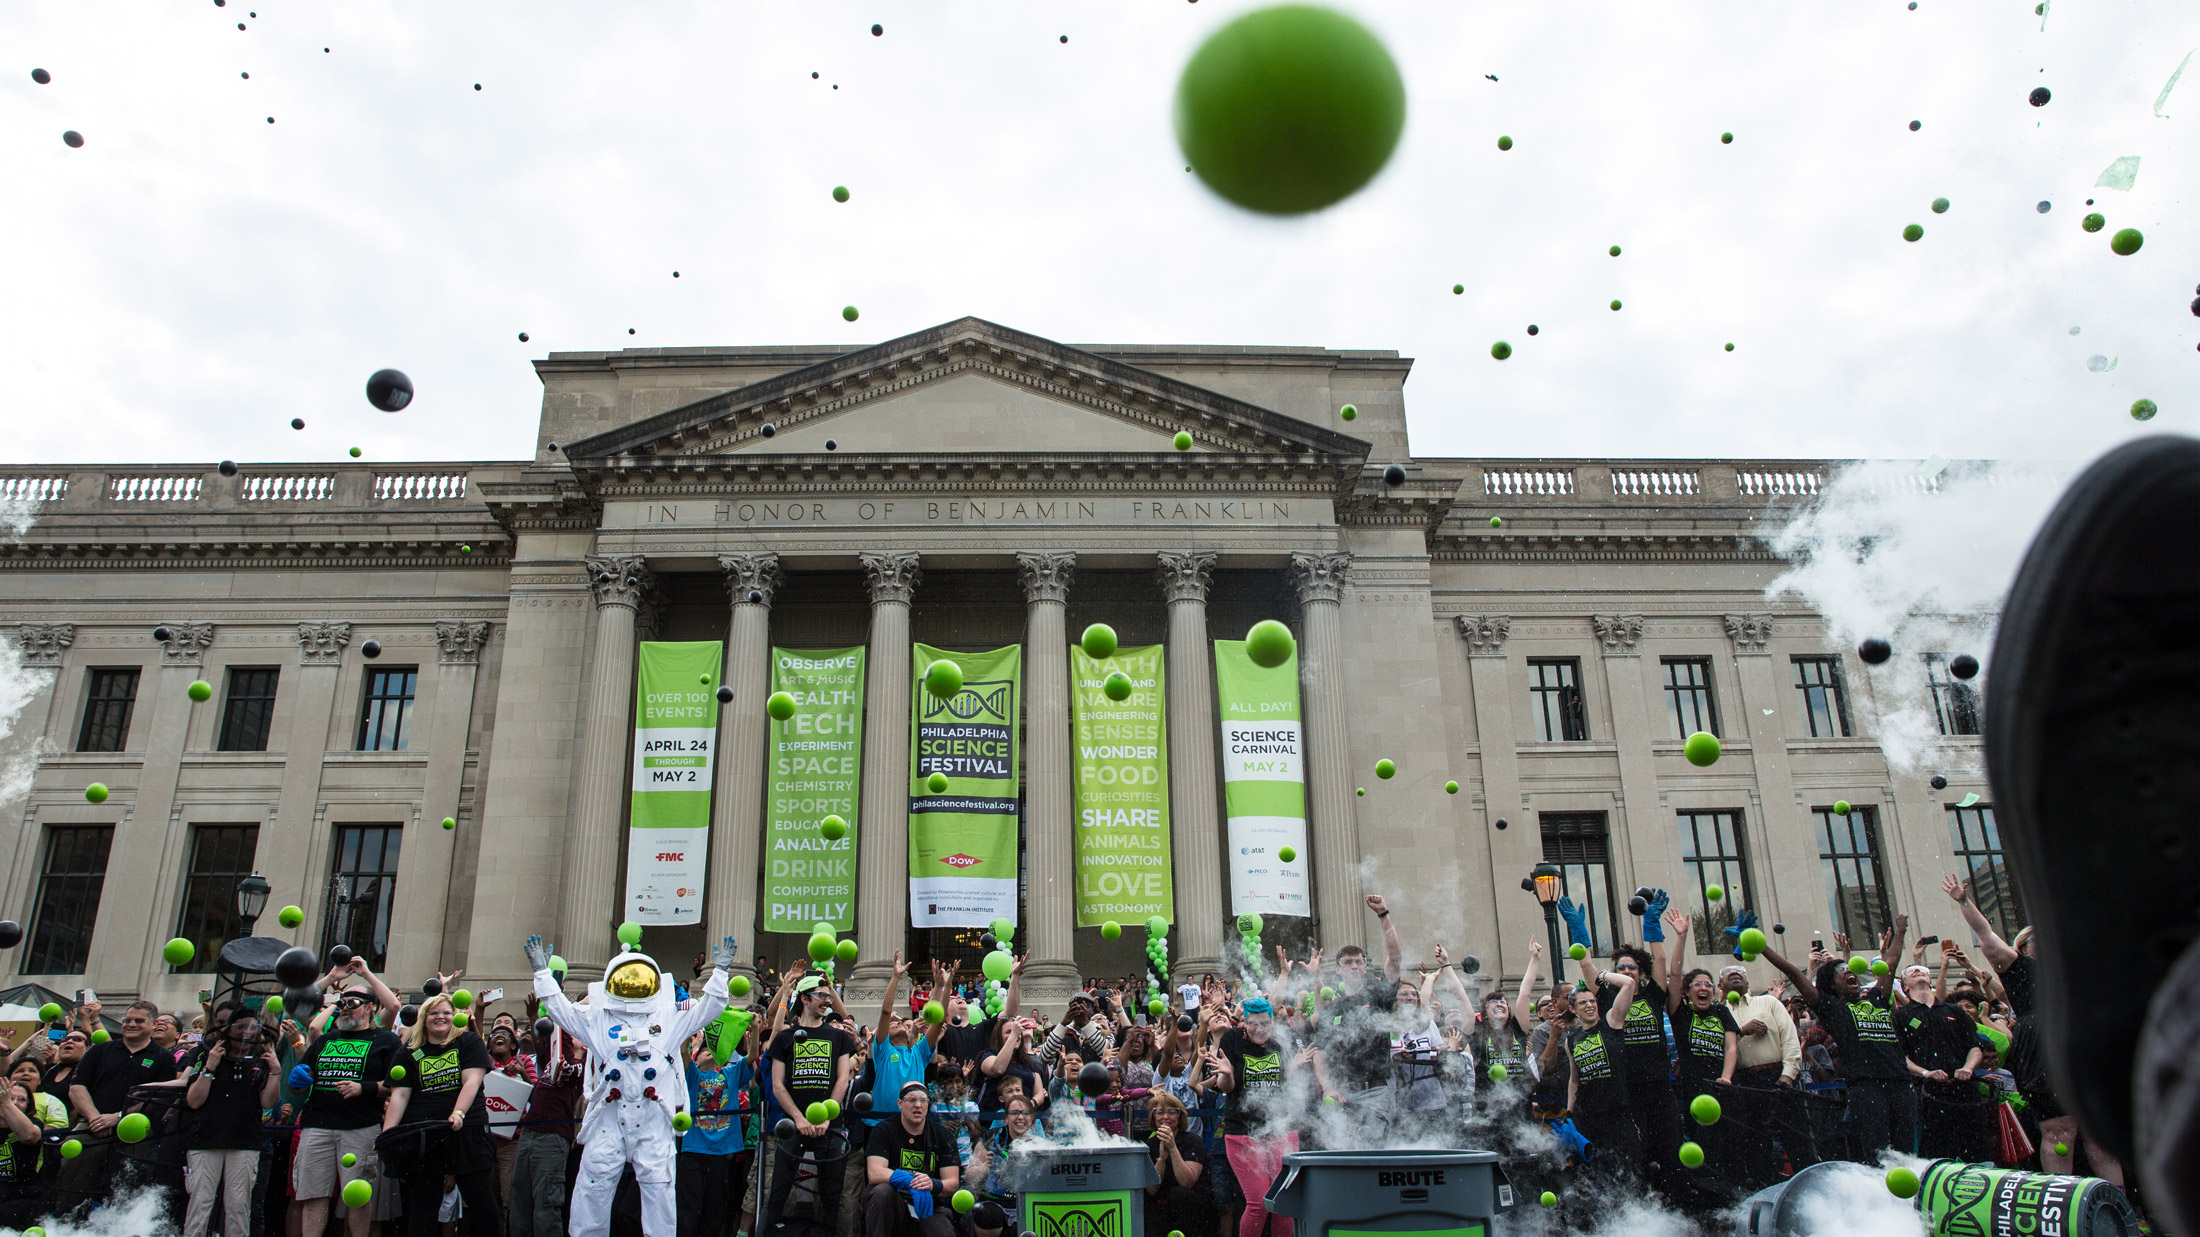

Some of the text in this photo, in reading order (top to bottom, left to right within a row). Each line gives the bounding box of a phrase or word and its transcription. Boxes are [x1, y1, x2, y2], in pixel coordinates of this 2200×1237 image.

[648, 502, 1289, 523] IN HONOR OF BENJAMIN FRANKLIN
[779, 656, 856, 670] OBSERVE
[1079, 655, 1156, 674] MATH
[779, 674, 856, 685] ART & MUSIC
[1079, 679, 1156, 689] UNDAND
[646, 693, 709, 703] OVER 100
[788, 691, 856, 706] EALTH
[646, 706, 708, 718] EVENTS!
[1230, 702, 1293, 713] ALL DAY!
[1080, 711, 1157, 721] ENGINEERING
[921, 727, 1008, 740] PHILADELPHIA
[1080, 725, 1158, 741] SENSES
[1231, 730, 1296, 743] SCIENCE
[644, 740, 708, 752] APRIL 24
[778, 740, 854, 752] EXPERIMENT
[921, 739, 1008, 758] SCIENCE
[1081, 745, 1158, 760] WONDER
[1231, 744, 1297, 756] CARNIVAL
[654, 758, 695, 766] THROUGH
[777, 756, 854, 776] SPACE
[920, 757, 1008, 774] FESTIVAL
[1243, 762, 1288, 773] MAY 2
[652, 771, 696, 782] MAY 2
[1081, 765, 1160, 785] FOOD
[775, 780, 853, 793] CHEMISTRY
[1081, 792, 1160, 803] CURIOSITIES
[775, 798, 852, 814] SPORTS
[912, 800, 1015, 812] philasciencefestival.org
[1082, 808, 1160, 828] SHARE
[775, 819, 851, 831] EDUCAN
[774, 837, 850, 851] ANALYZE
[1082, 835, 1161, 850] ANIMALS
[656, 852, 684, 861] FMC
[1082, 855, 1163, 866] INNOVATION
[773, 859, 849, 878] DRINK
[772, 885, 849, 897] COMPUTERS
[1083, 872, 1163, 897] LOVE
[772, 902, 848, 921] PHILLY
[1083, 903, 1163, 914] ASTRONOMY
[1858, 1021, 1892, 1029] FESTIVAL
[1691, 1032, 1724, 1045] SCIENCE
[1691, 1038, 1723, 1051] FESTIVAL
[1489, 1050, 1521, 1058] SCIENCE
[1576, 1052, 1605, 1068] SCIENCE
[317, 1063, 362, 1071] SCIENCE
[1580, 1059, 1607, 1073] FESTIVAL
[318, 1070, 359, 1078] FESTIVAL
[422, 1067, 459, 1081] PHILADELPHIA
[424, 1072, 460, 1087] SCIENCE
[1245, 1073, 1280, 1081] SCIENCE
[1245, 1080, 1280, 1088] FESTIVAL
[1051, 1163, 1102, 1175] BRUTE
[1378, 1170, 1446, 1187] BRUTE
